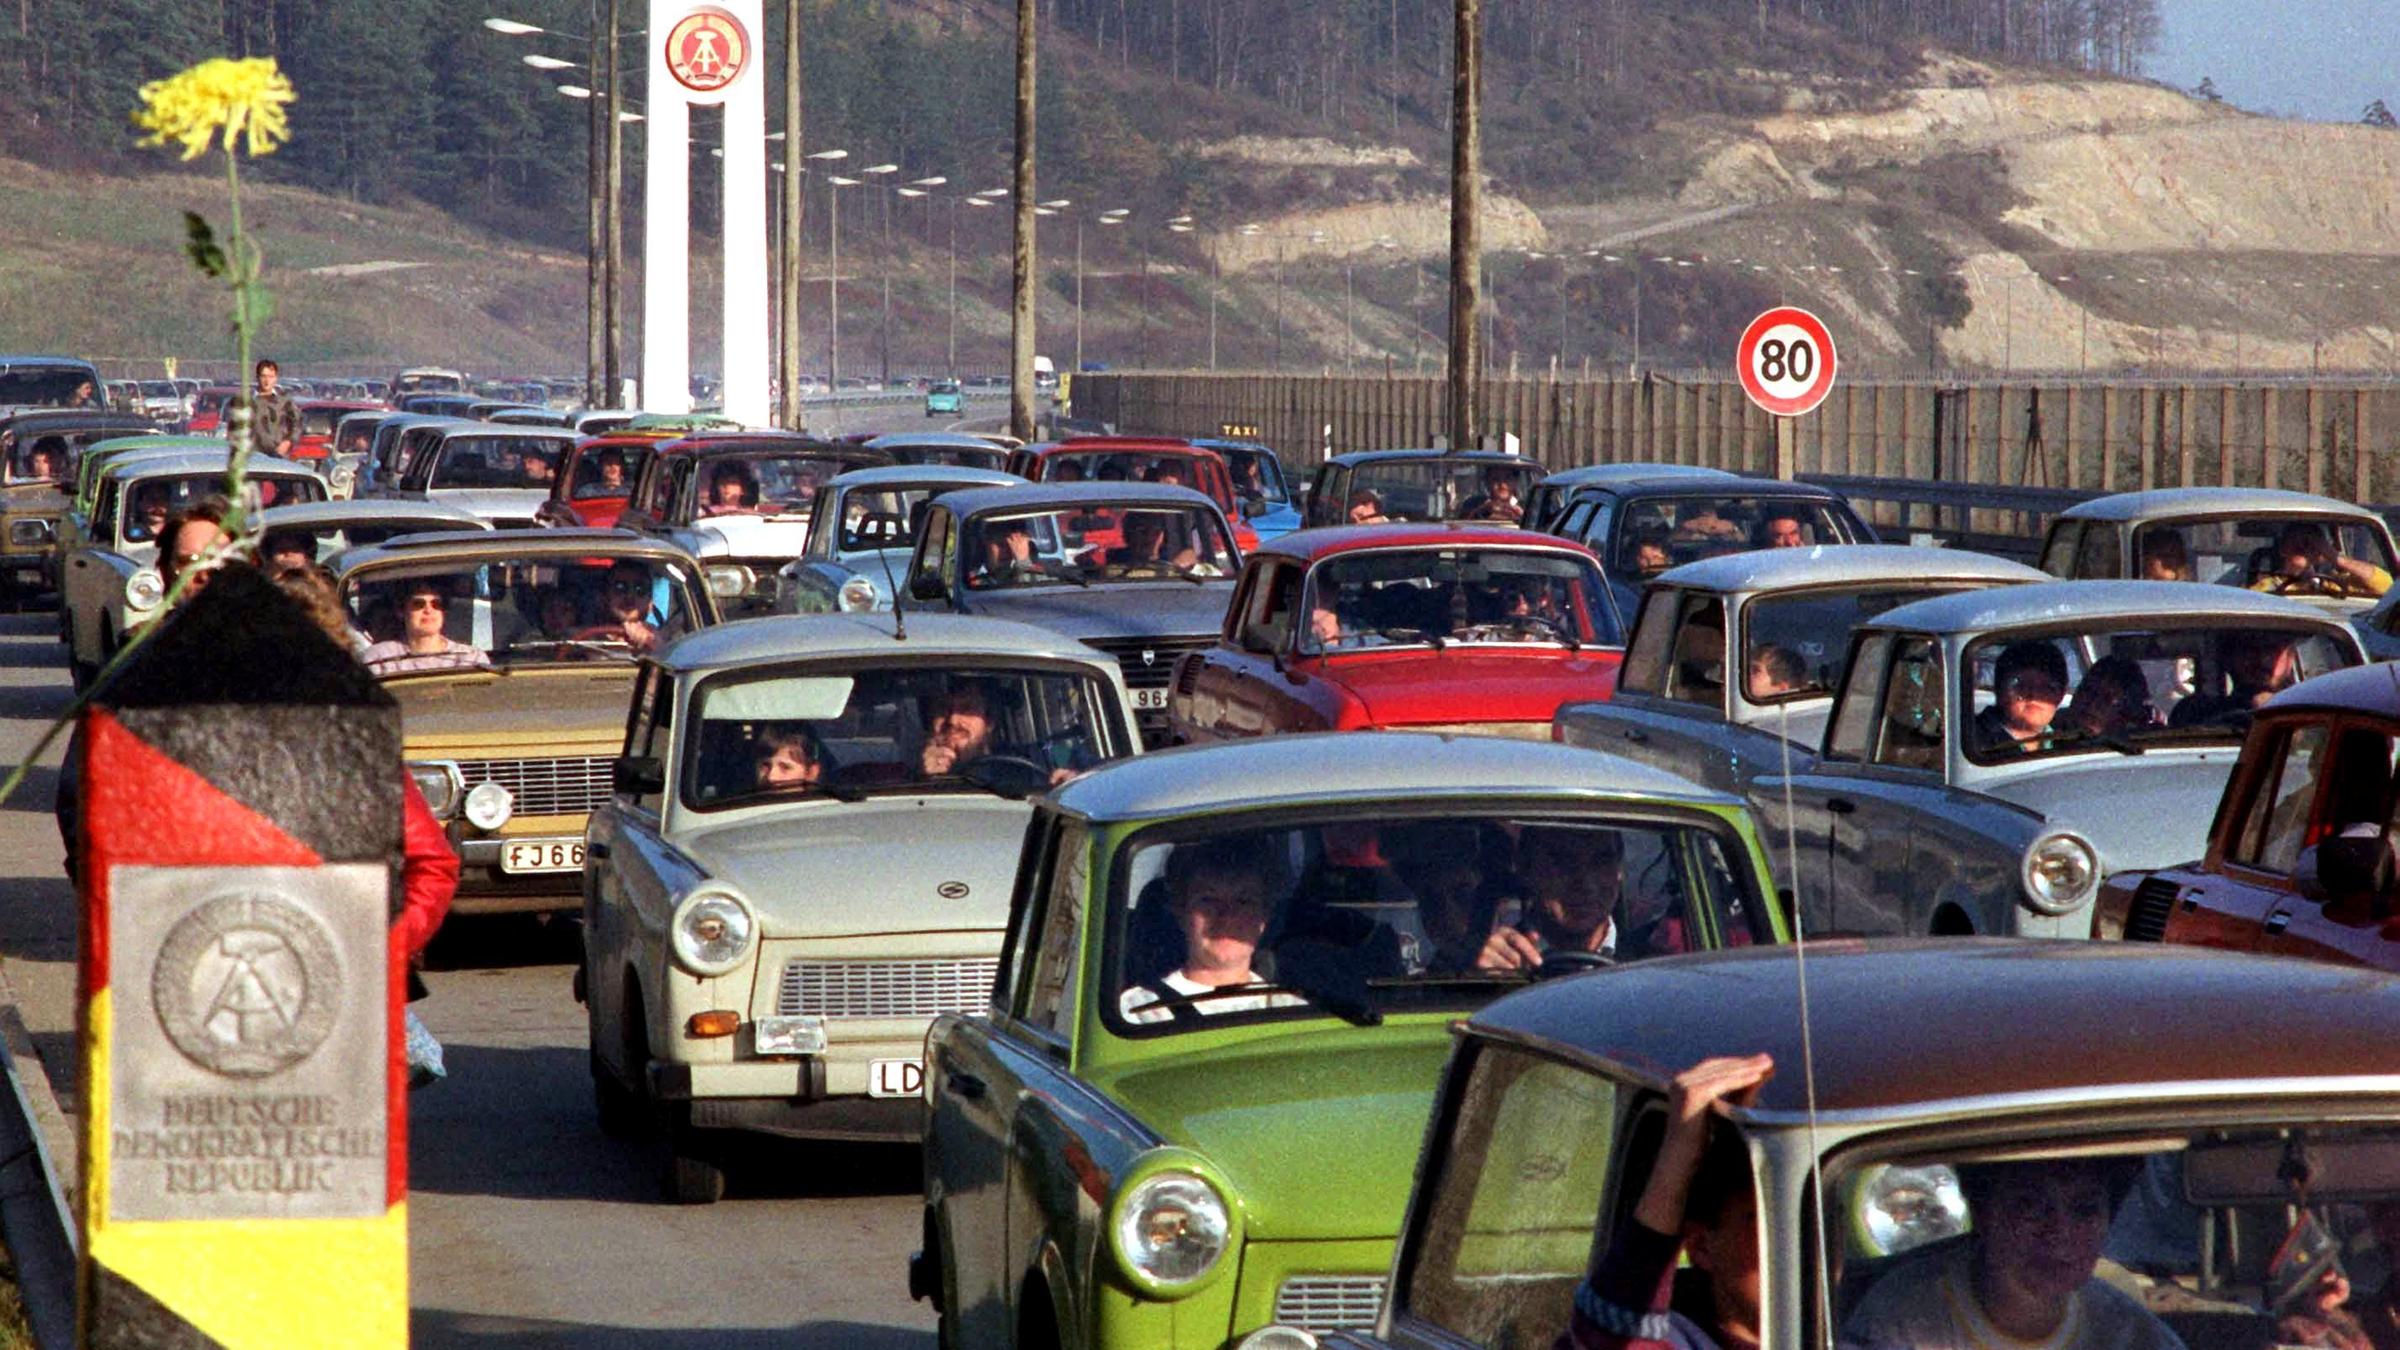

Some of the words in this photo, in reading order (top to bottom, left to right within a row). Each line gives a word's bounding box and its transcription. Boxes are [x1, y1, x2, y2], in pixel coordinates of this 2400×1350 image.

[1761, 339, 1813, 382] 80
[1222, 424, 1258, 437] TAXI
[881, 1063, 923, 1093] LD
[163, 1094, 336, 1126] DEUTSCHE
[113, 1128, 385, 1158] DEMOKRATISCHE
[166, 1161, 335, 1193] REPUBLIK
